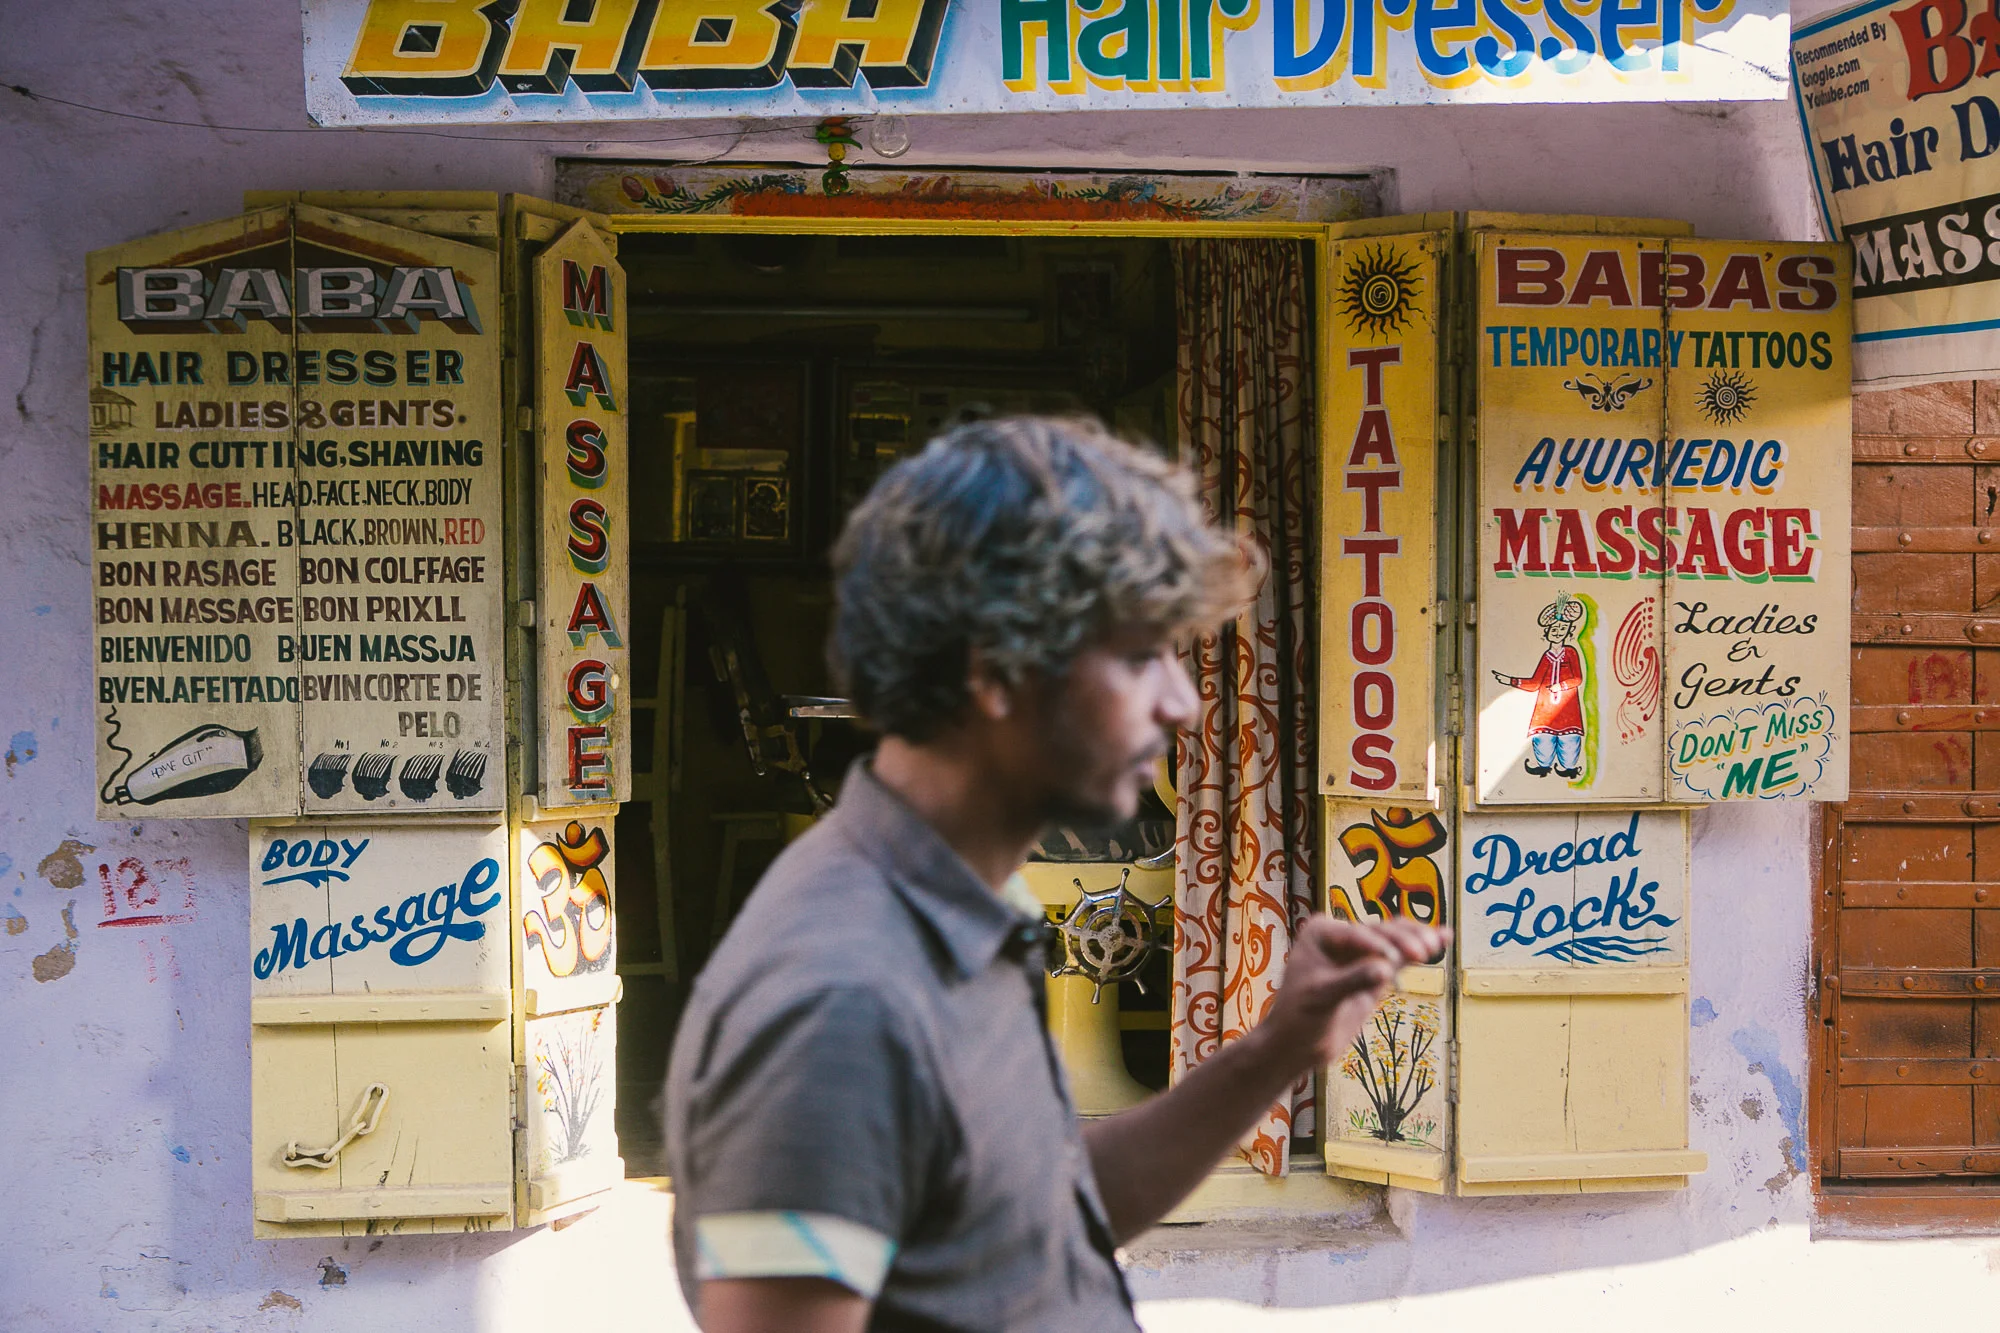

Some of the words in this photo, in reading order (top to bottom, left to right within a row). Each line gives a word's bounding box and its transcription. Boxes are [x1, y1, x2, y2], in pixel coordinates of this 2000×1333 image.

[1795, 26, 1869, 66] Recommended
[1870, 22, 1886, 41] By
[1820, 118, 1939, 194] Hair
[117, 266, 480, 334] BABA
[1495, 248, 1839, 313] BABA'S
[102, 351, 204, 386] HAIR
[227, 349, 464, 386] DRESSER
[1486, 326, 1684, 368] TEMPORARY
[1689, 331, 1833, 370] TATTOOS
[99, 442, 180, 469] HAIR
[1513, 437, 1788, 494] AYURVEDIC
[561, 258, 622, 799] MASSAGE
[1494, 505, 1821, 583] MASSAGE
[99, 561, 156, 586] BON
[163, 559, 276, 586] RASAGE
[301, 557, 359, 585] BON
[1342, 344, 1402, 792] TATTOOS
[99, 597, 153, 624] BON
[161, 597, 294, 624] MASSAGE
[303, 596, 359, 622] BON
[366, 596, 466, 622] PRIXLL
[1673, 602, 1818, 635] Ladies
[101, 634, 251, 663] BIENVENIDO
[278, 634, 352, 663] BUEN
[360, 634, 476, 662] MASSJA
[447, 674, 482, 702] DE
[1674, 662, 1801, 709] Gents
[398, 711, 462, 738] PELO
[1678, 722, 1758, 767] DON'T
[1763, 711, 1824, 747] MISS
[392, 741, 398, 749] 2
[261, 838, 370, 872] BODY
[1465, 811, 1642, 894] Dread
[253, 857, 501, 981] Massage
